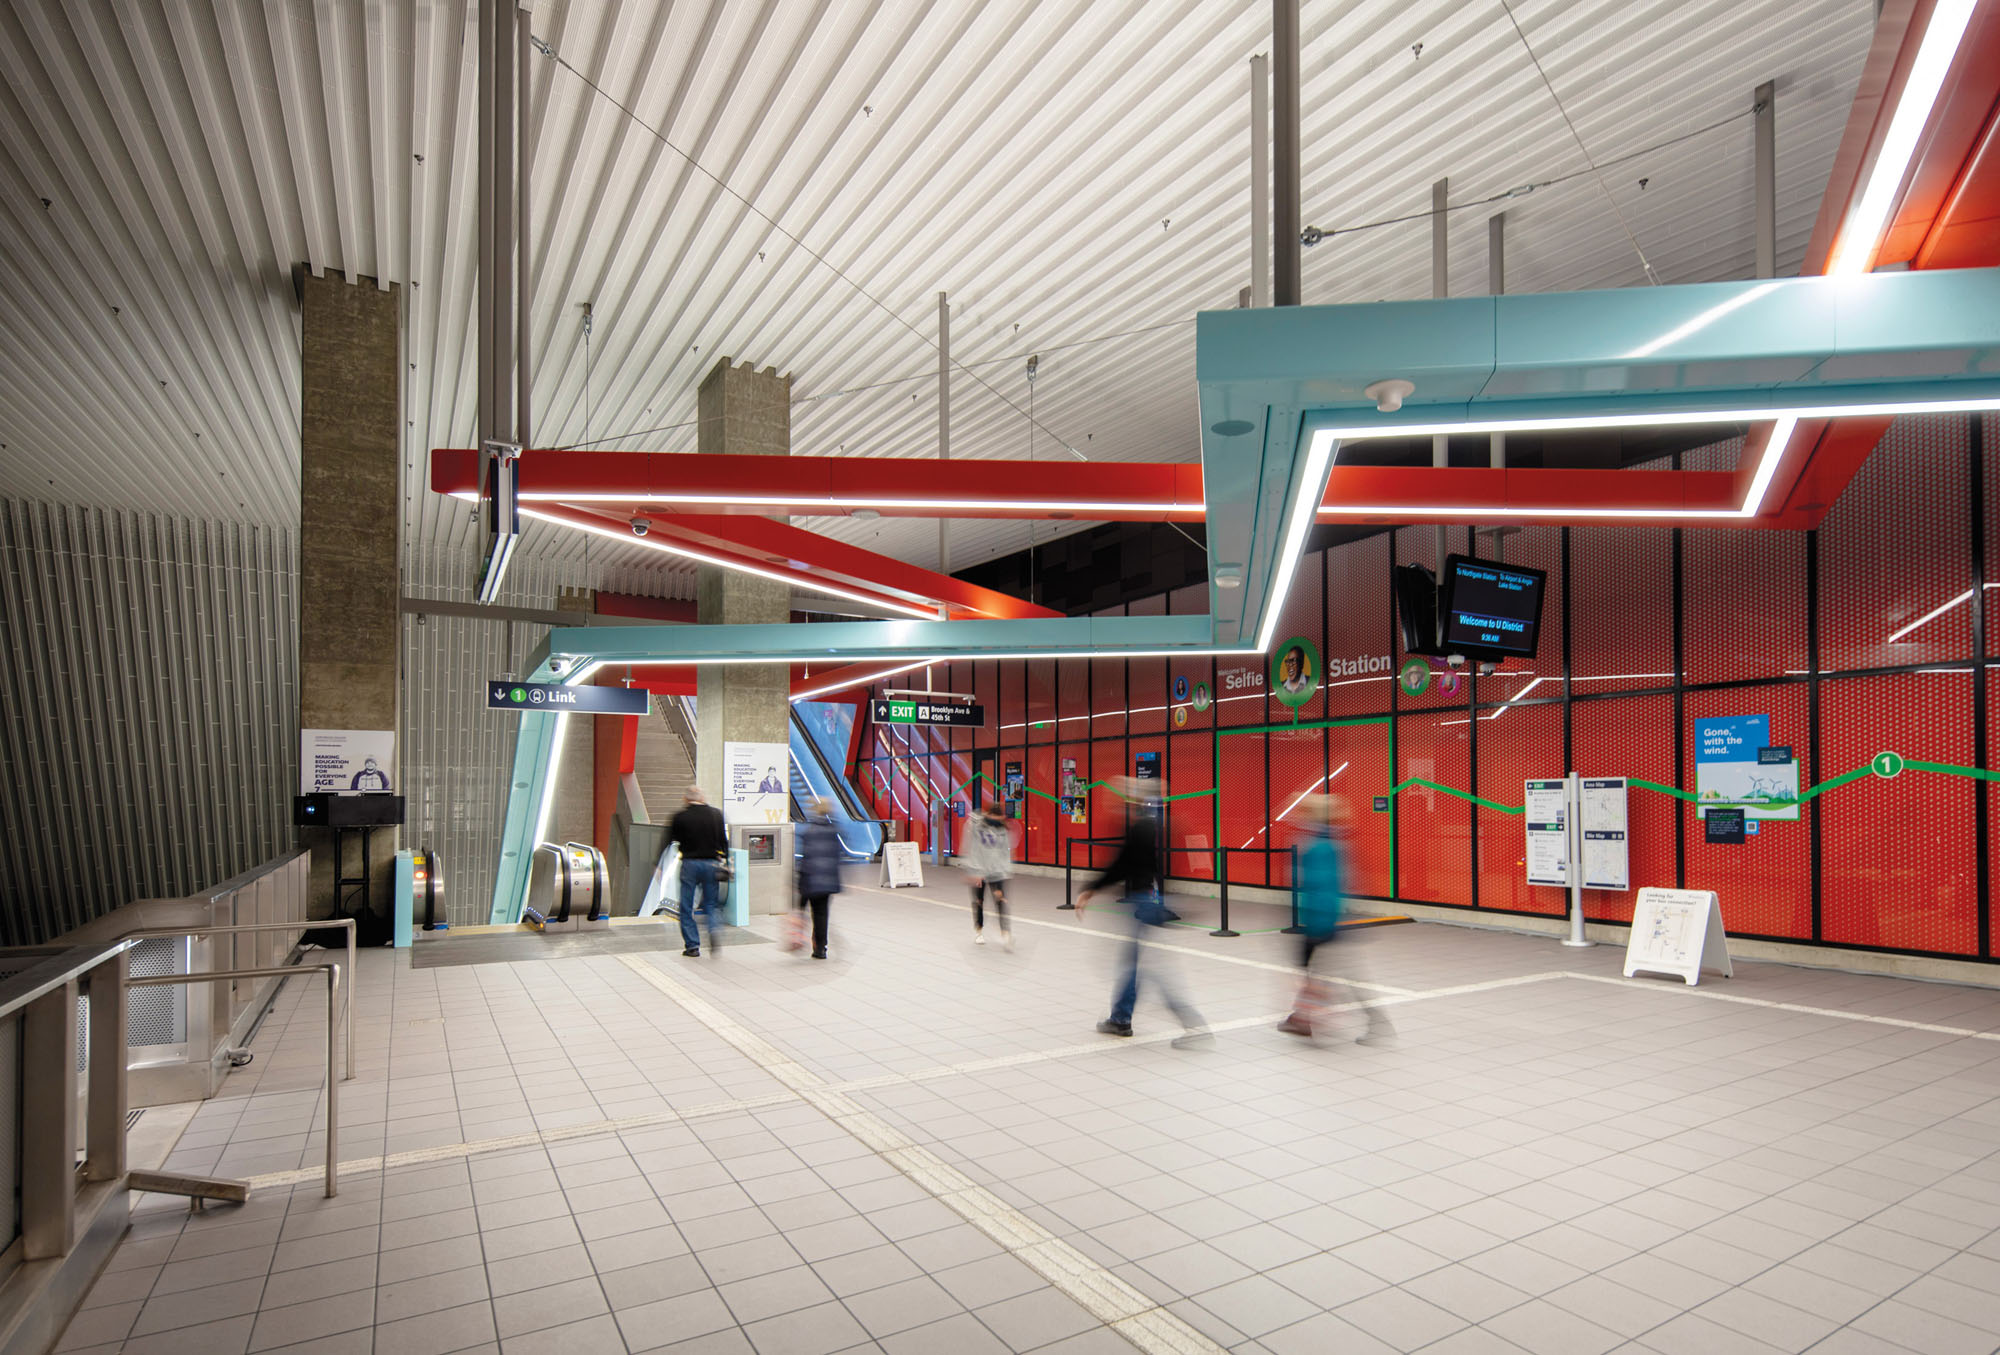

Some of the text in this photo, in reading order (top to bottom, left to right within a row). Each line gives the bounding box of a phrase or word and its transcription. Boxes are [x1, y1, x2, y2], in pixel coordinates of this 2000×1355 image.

[1459, 614, 1524, 632] Welcome to U District
[1217, 668, 1239, 676] Welcome
[1225, 655, 1391, 690] Selfie Station
[549, 691, 576, 703] Link
[891, 706, 914, 718] EXIT
[920, 708, 928, 717] A
[931, 706, 953, 714] Brooklyn
[1704, 728, 1732, 737] Gone,
[1704, 737, 1743, 746] with the
[1704, 746, 1729, 755] wind.
[1881, 756, 1890, 773] 1
[764, 809, 784, 824] W
